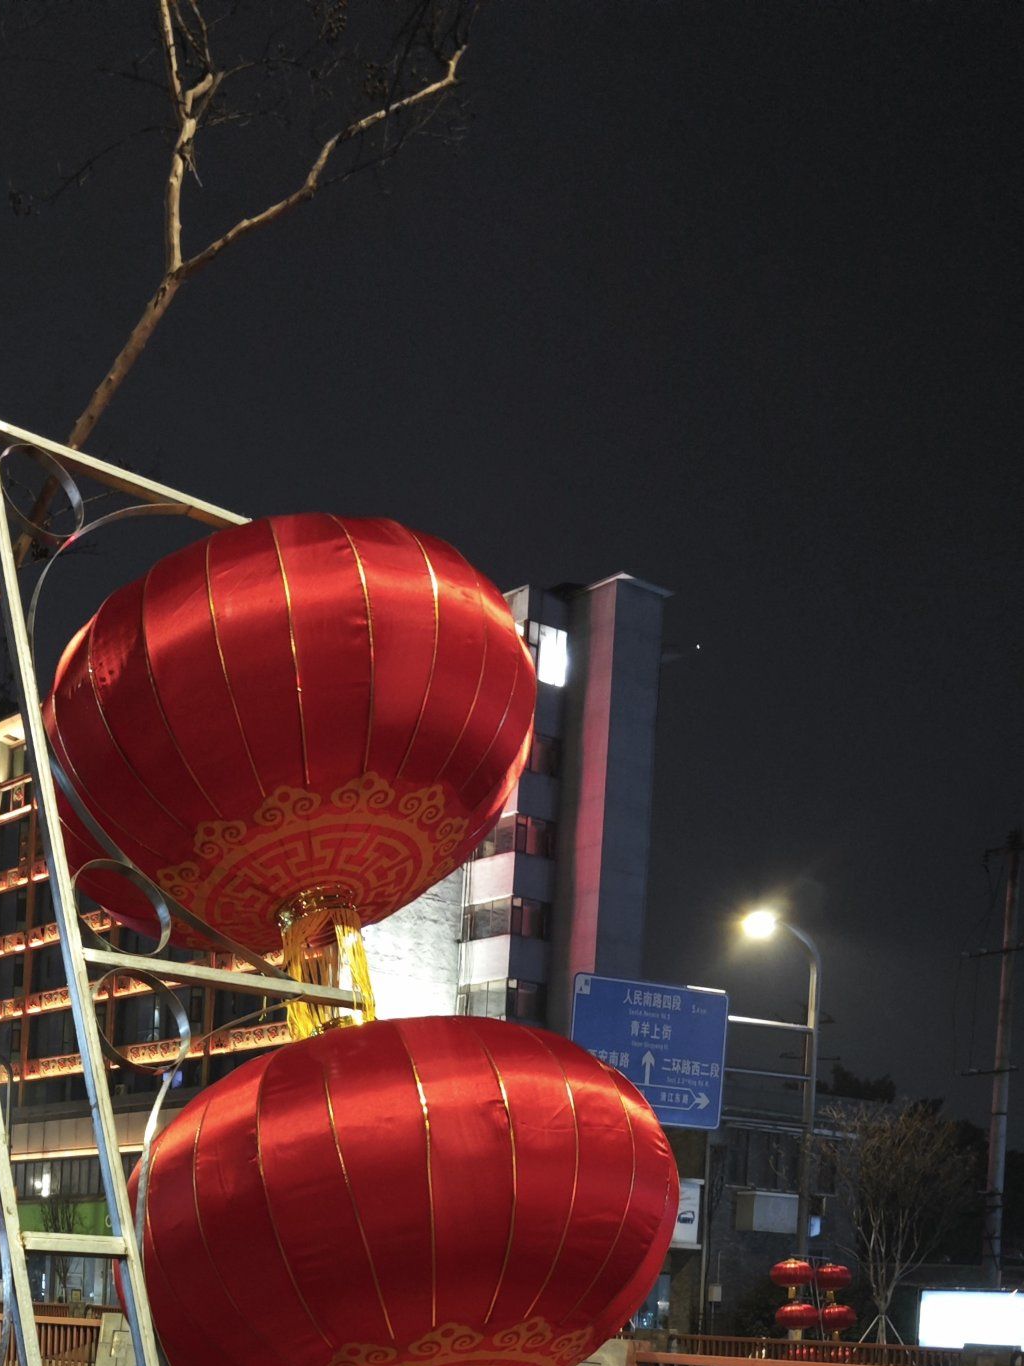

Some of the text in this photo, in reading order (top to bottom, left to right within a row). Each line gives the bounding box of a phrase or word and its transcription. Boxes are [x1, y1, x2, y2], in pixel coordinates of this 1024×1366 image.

[623, 988, 682, 1011] 人民南路四段
[630, 1020, 673, 1041] 青羊上街
[662, 1058, 720, 1078] 二环路西二段
